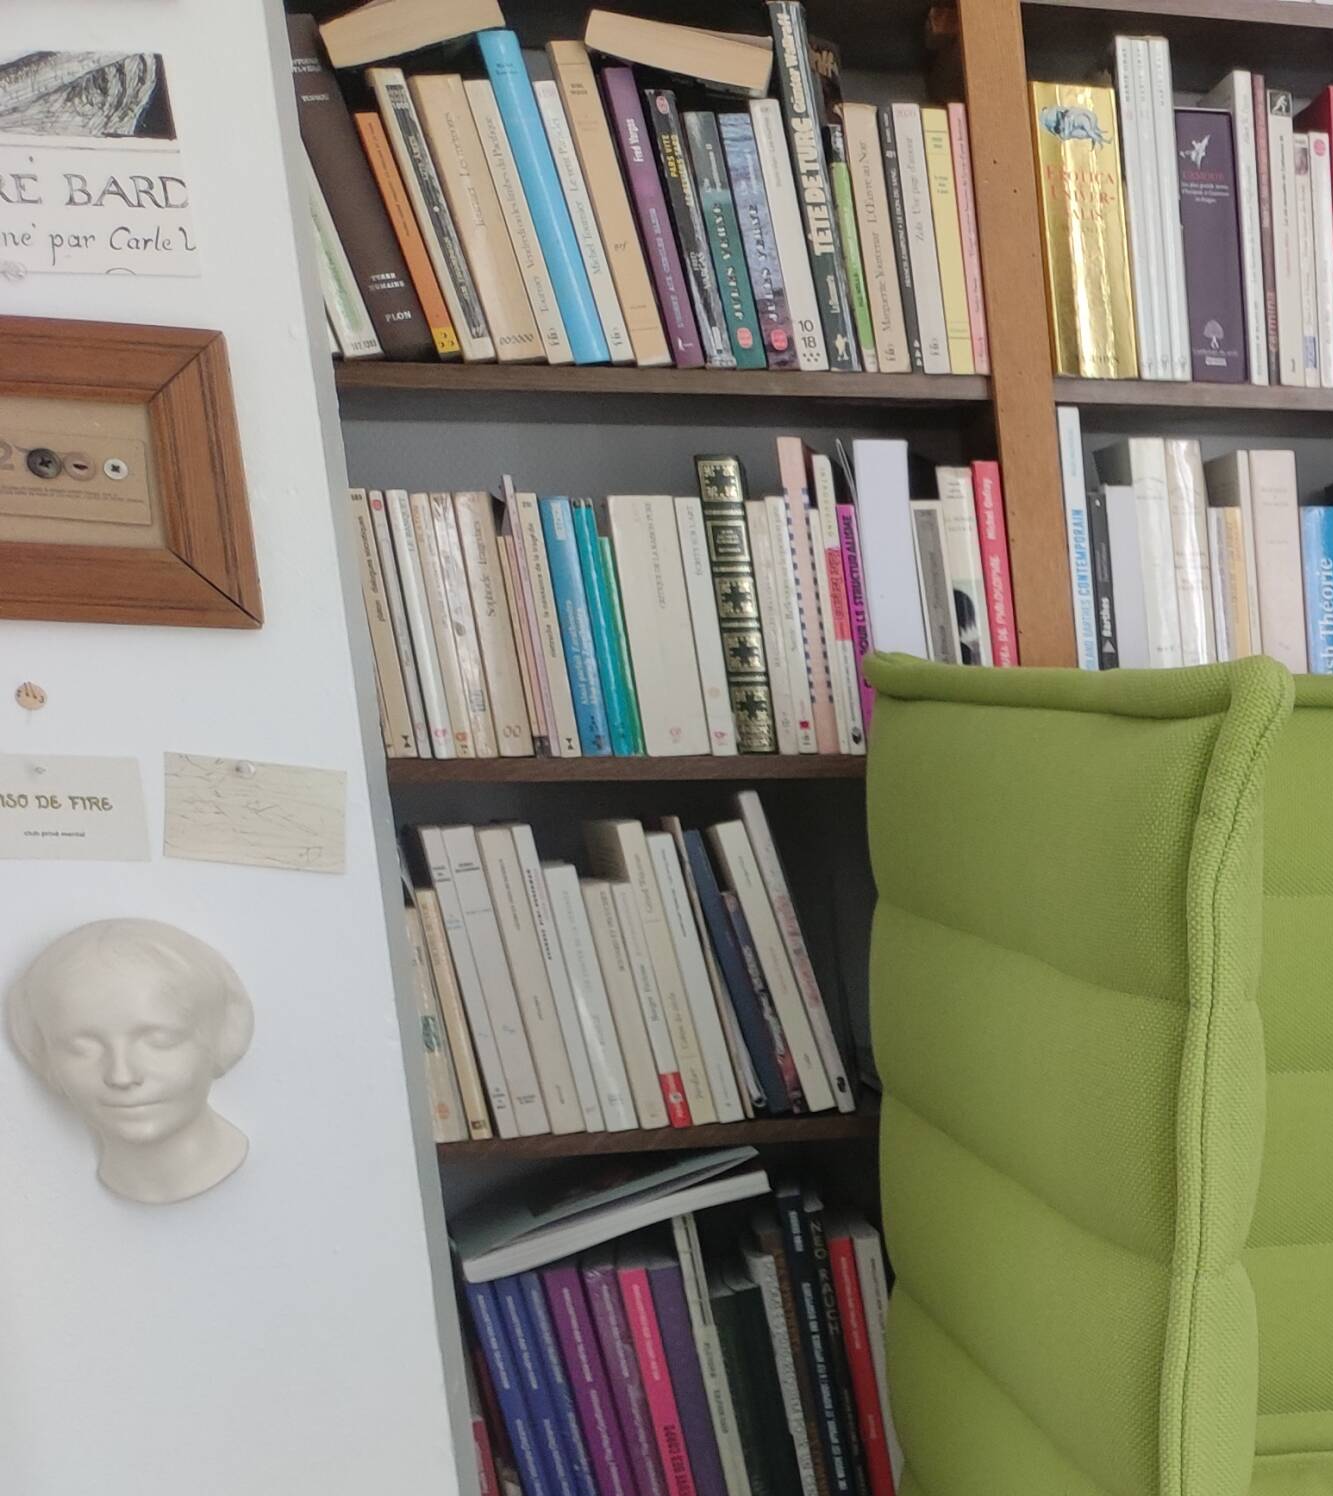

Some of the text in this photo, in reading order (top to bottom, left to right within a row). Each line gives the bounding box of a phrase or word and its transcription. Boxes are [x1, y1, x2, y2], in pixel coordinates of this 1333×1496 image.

[625, 118, 645, 163] Fred Vargas
[660, 133, 680, 178] PARS VITE
[792, 116, 834, 256] TÊTE DE TURC
[48, 232, 96, 266] par
[109, 226, 173, 252] Carle
[711, 202, 744, 321] JULES VERNE
[748, 204, 778, 322] JULES VERNE
[385, 310, 412, 322] PLON
[798, 320, 814, 332] 10
[803, 335, 817, 349] 18
[984, 509, 997, 540] Michel
[843, 514, 864, 607] STRUCTURALISME
[1071, 508, 1091, 597] CONTEMPORAIN
[1101, 597, 1112, 637] Barthes
[35, 795, 62, 809] DE
[68, 795, 113, 812] FIRE
